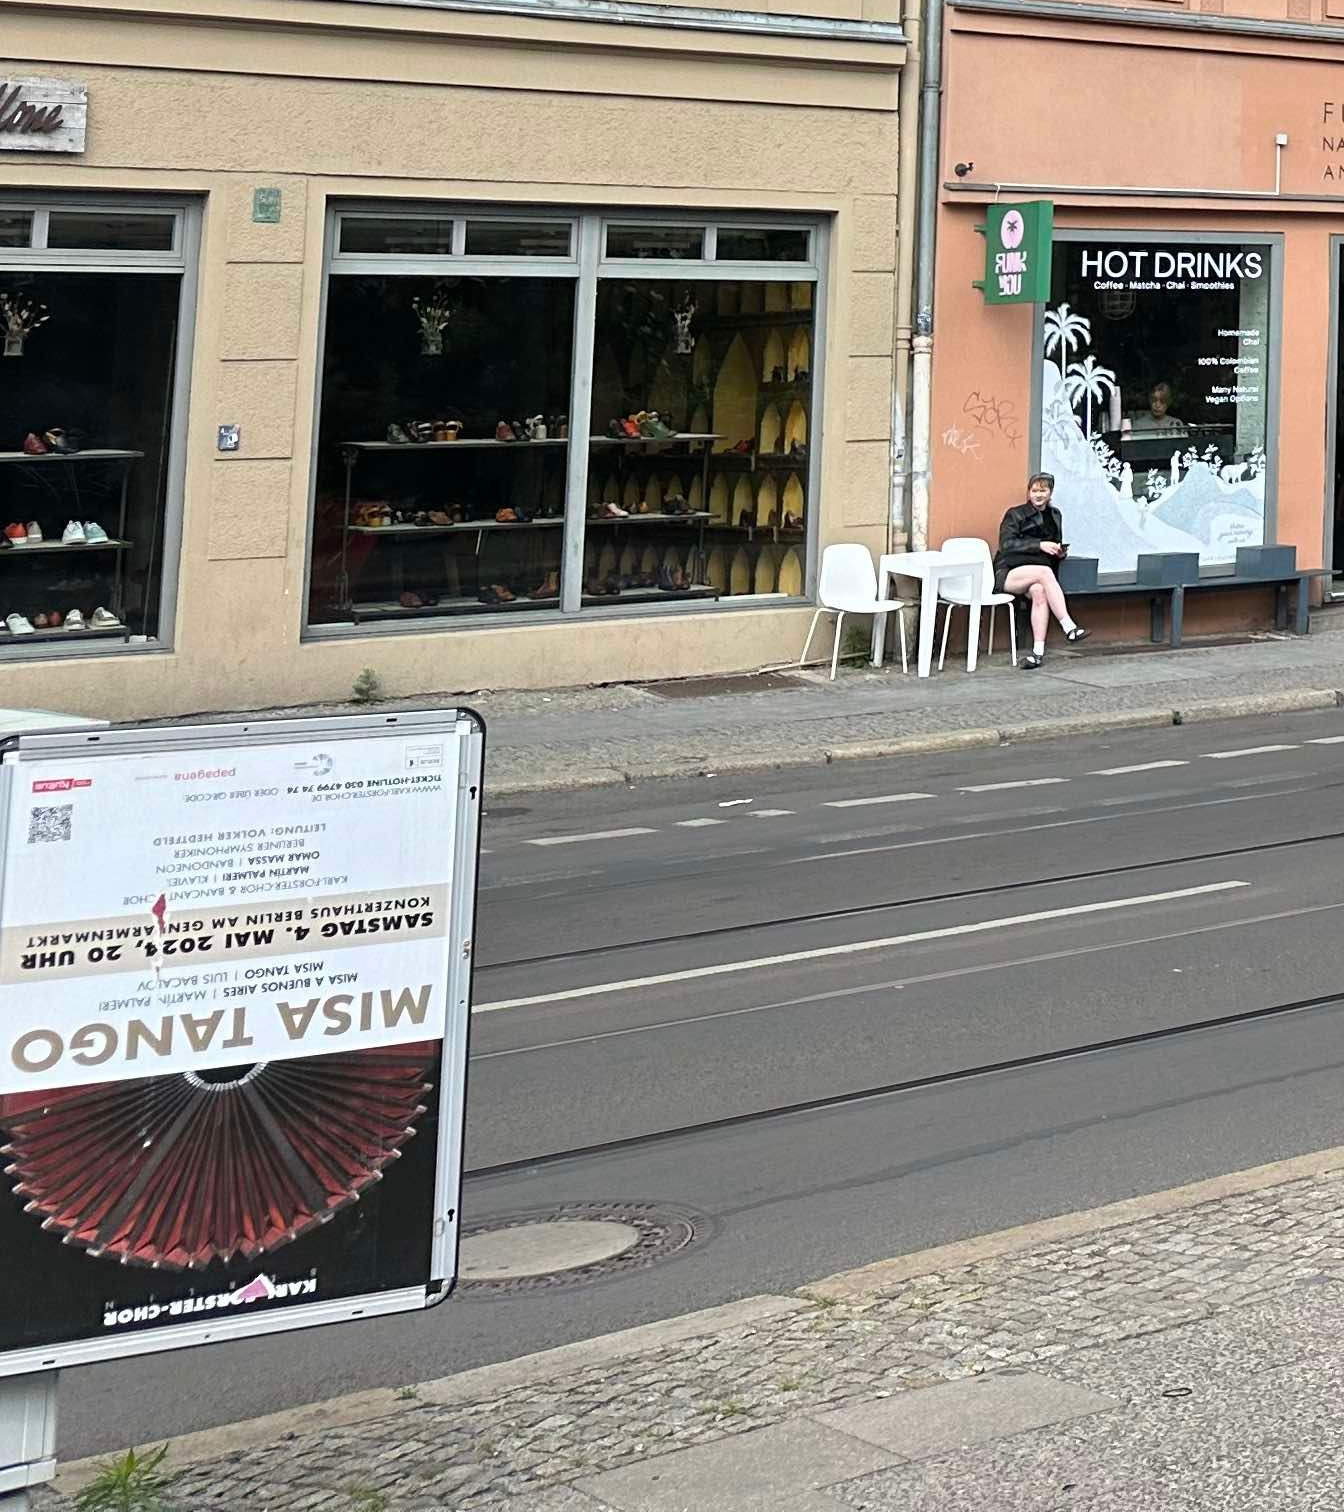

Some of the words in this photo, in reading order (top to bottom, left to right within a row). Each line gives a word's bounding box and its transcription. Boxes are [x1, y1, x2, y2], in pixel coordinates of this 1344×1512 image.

[995, 251, 1027, 274] FUNK
[1081, 250, 1148, 278] HOT
[1154, 251, 1263, 279] DRINKS
[999, 274, 1022, 296] YOU
[1093, 281, 1124, 290] Coffee
[1129, 281, 1161, 290] Matcha
[1165, 281, 1186, 290] Chai
[1190, 281, 1235, 290] Smoothies
[1218, 329, 1260, 337] Homemade
[1198, 357, 1219, 365] 100%
[1205, 396, 1229, 405] Vegan
[174, 767, 236, 782] papagena
[366, 774, 442, 788] TICKET-HOTLINE
[217, 828, 266, 841] VOLKER
[271, 822, 327, 836] LEITUNG:
[173, 842, 254, 858] SYMPHONIKER
[257, 838, 305, 851] BERLINER
[247, 853, 285, 865] MASSA
[288, 850, 320, 862] OMAR
[155, 858, 234, 874] BANDONEON
[269, 865, 310, 881] MARTÍN
[222, 869, 266, 882] PALMERI
[229, 886, 236, 894] &
[310, 896, 431, 919] KONZERTHAUS
[211, 917, 239, 929] AM
[246, 910, 303, 926] BERLIN
[320, 912, 434, 938] SAMSTAG
[26, 921, 204, 948] GENARMENMARKT
[224, 929, 275, 948] MAI
[285, 926, 310, 941] 4.
[87, 944, 122, 963] 20
[135, 935, 213, 957] 2024,
[20, 950, 75, 970] UHR
[294, 960, 324, 973] MISA
[202, 972, 229, 984] LUIS
[244, 965, 289, 979] TANGO
[328, 972, 358, 985] MISA
[261, 978, 311, 993] BUENOS
[315, 976, 324, 986] A
[223, 983, 258, 998] AIRES
[98, 996, 151, 1012] PALMERI
[276, 984, 433, 1040] MISA
[10, 1007, 254, 1073] TANGO
